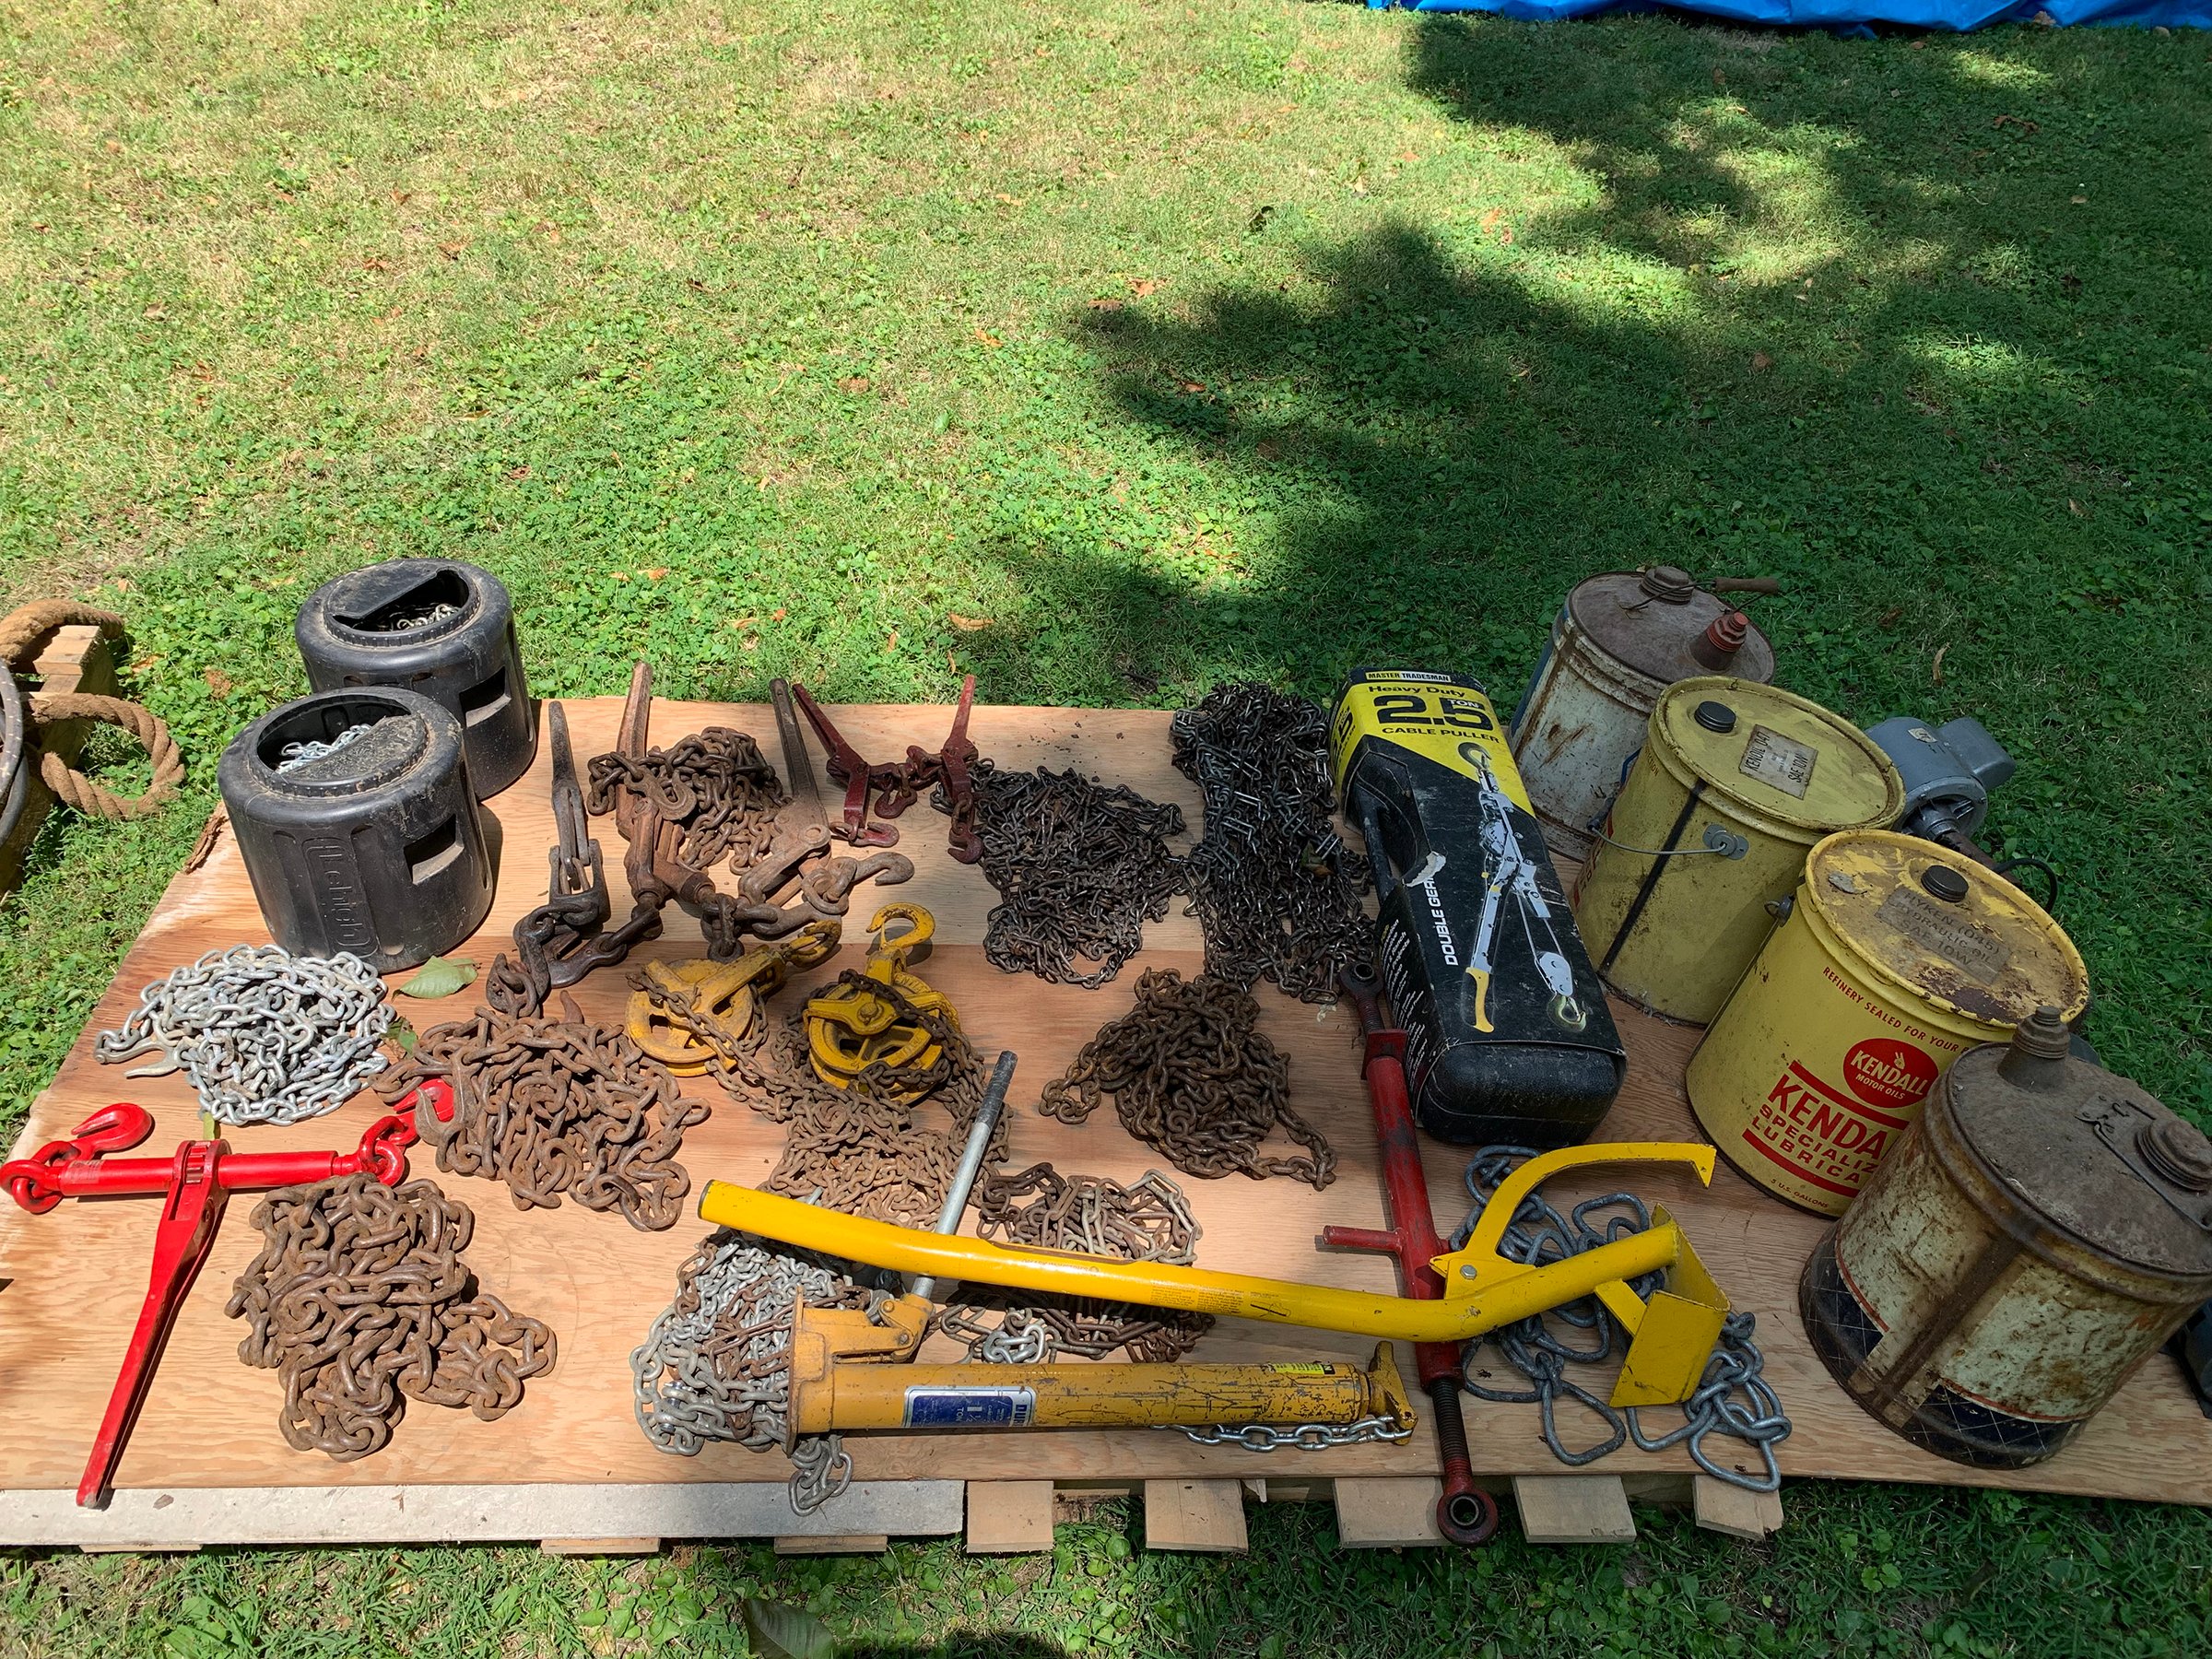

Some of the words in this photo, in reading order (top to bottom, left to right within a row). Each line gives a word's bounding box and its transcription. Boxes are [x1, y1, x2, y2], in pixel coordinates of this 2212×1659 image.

[1368, 672, 1400, 680] MASTER
[1401, 673, 1450, 682] TRADESMAN
[1368, 686, 1421, 694] Heavy
[1426, 687, 1465, 699] Duty
[1447, 699, 1479, 709] TON
[1372, 694, 1494, 732] 2.5
[1382, 726, 1436, 735] CABLE
[1441, 729, 1500, 744] PULLER
[1744, 746, 1766, 772] KENOIL
[1792, 753, 1808, 771] 10W
[1787, 767, 1805, 783] SAE
[1894, 902, 1969, 949] HYDRAULIC
[1971, 948, 1993, 966] OIL
[1903, 892, 1955, 926] HYKEN
[1958, 925, 2000, 956] (045)
[1430, 909, 1459, 966] DOUBLE
[1936, 940, 1973, 966] 10W
[1822, 967, 1865, 1005] REFINERY
[1864, 1002, 1902, 1029] SEALED
[1903, 1025, 1926, 1041] FOR
[1929, 1035, 1959, 1053] YOUR
[1851, 1050, 1929, 1096] KENDALL
[1855, 1073, 1884, 1092] MOTOR
[1884, 1087, 1906, 1100] OILS
[1767, 1073, 1890, 1161] KENDA
[1778, 1182, 1792, 1194] U.S.
[1794, 1191, 1829, 1208] GALLONS
